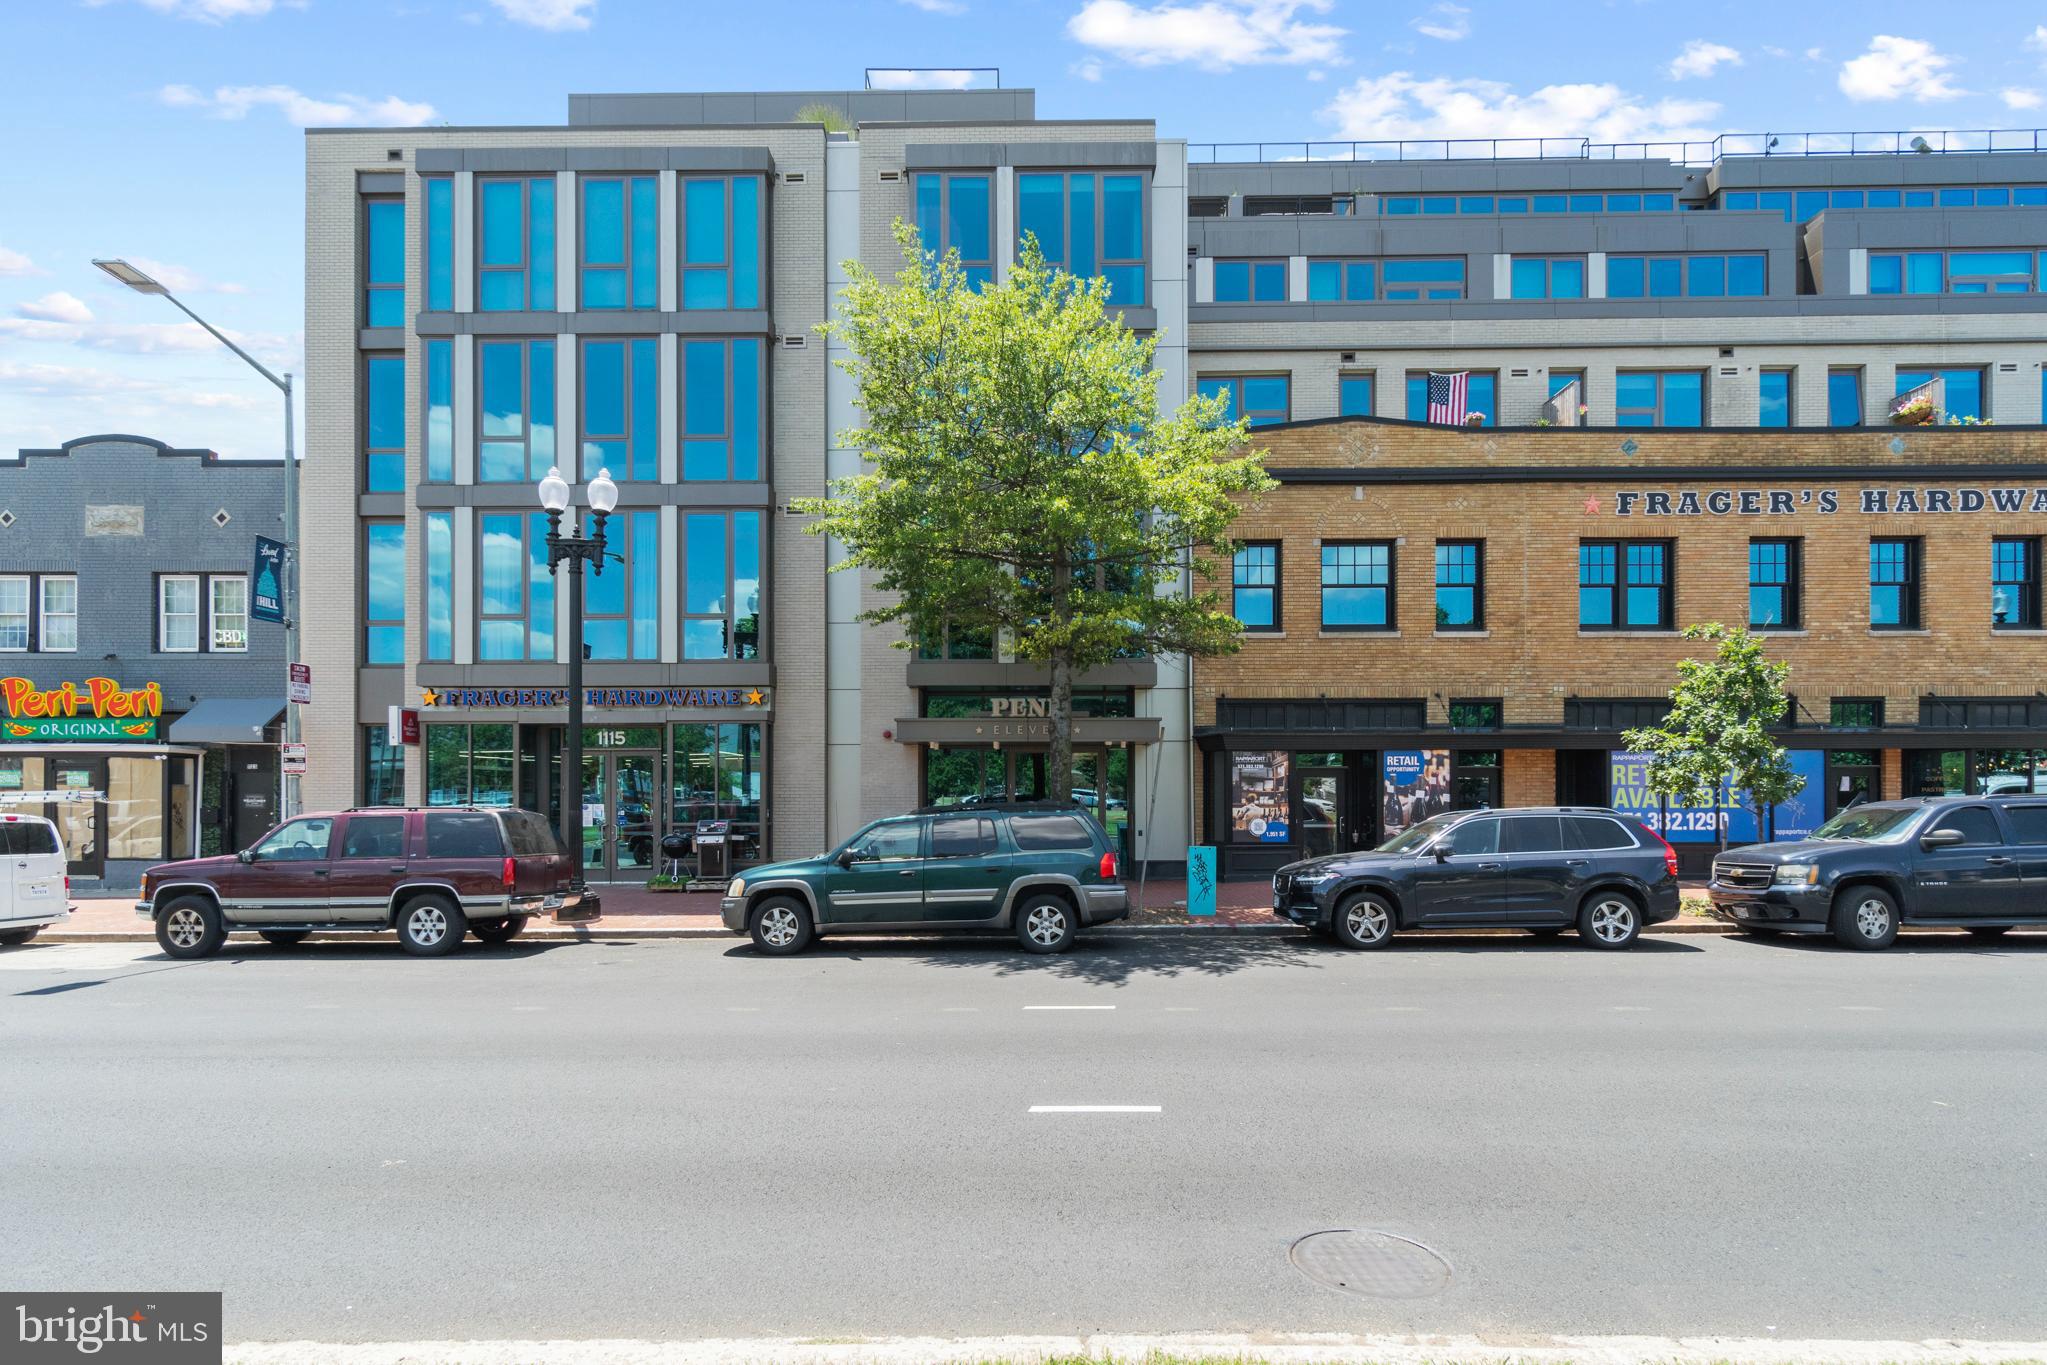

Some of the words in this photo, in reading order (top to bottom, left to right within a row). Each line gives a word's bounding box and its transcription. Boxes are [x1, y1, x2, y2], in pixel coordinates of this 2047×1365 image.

[1616, 490, 1839, 515] FRAGER'S
[215, 630, 241, 643] CBD
[0, 677, 162, 718] Peri-Peri
[586, 689, 743, 706] HARDWARE
[991, 698, 1051, 717] PEN
[40, 723, 119, 735] ORIGINAL
[994, 725, 1049, 735] ELEVE
[597, 731, 626, 745] 1115
[1387, 756, 1420, 766] RETAIL
